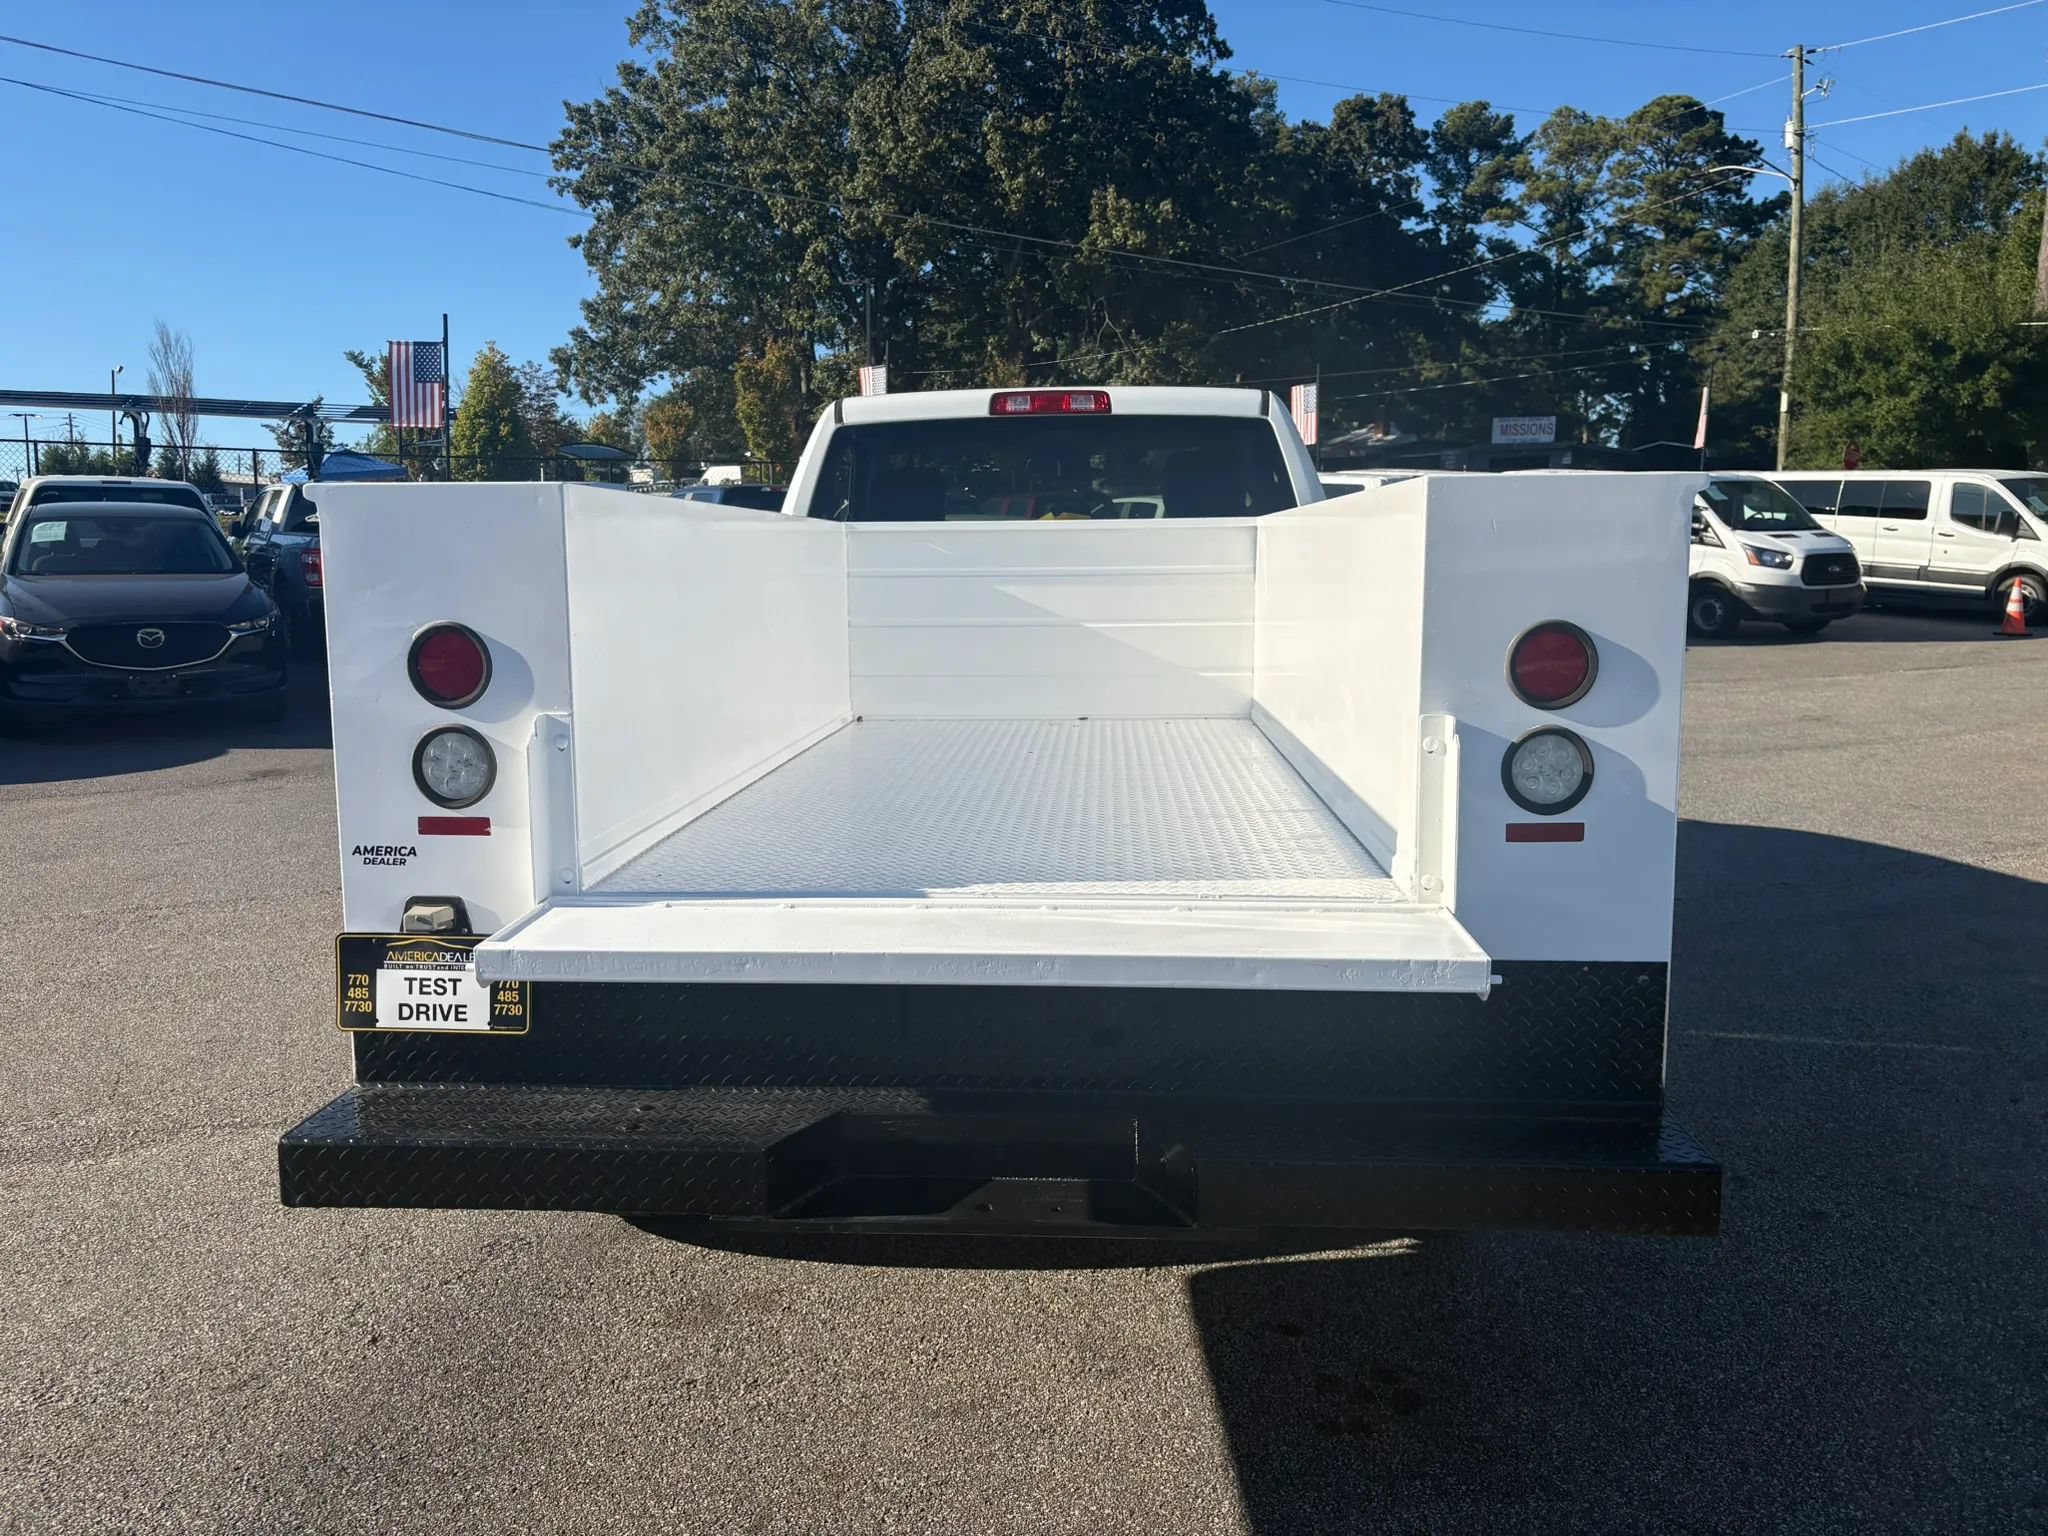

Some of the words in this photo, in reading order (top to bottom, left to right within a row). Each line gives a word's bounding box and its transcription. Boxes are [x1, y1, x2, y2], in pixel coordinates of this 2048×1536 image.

[352, 845, 417, 857] AMERICA
[363, 857, 407, 866] DEALER
[347, 974, 369, 985] 770
[403, 977, 462, 996] TEST
[347, 987, 369, 999] 485
[497, 990, 519, 1002] 485
[344, 1000, 373, 1012] 7730
[494, 1004, 523, 1016] 7730
[398, 1003, 468, 1022] DRIVE
